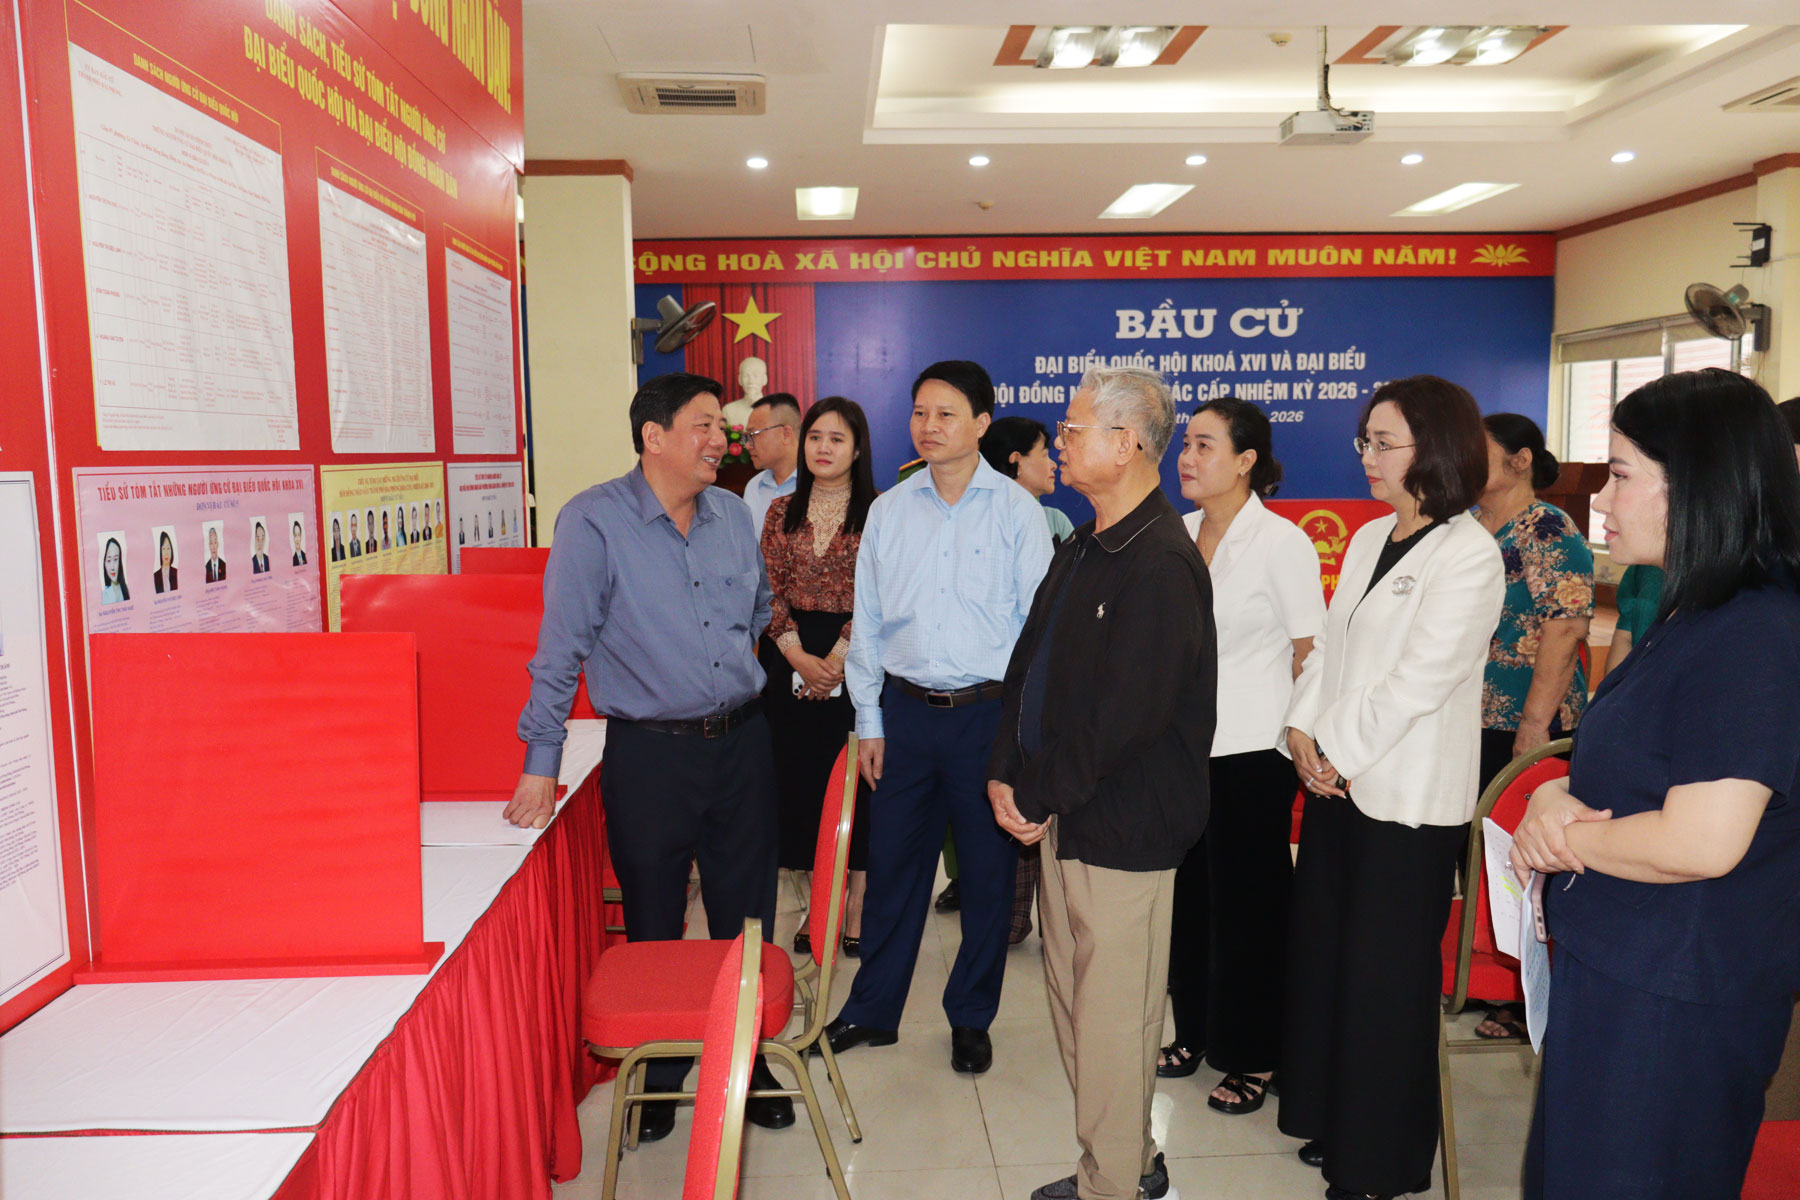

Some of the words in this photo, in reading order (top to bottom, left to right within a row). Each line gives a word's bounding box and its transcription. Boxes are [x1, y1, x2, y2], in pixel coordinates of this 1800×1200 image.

[299, 15, 330, 69] SÁCH,
[331, 39, 351, 81] TIỂU
[353, 56, 366, 92] SỬ
[366, 70, 384, 108] TÓM
[385, 82, 399, 119] TẮT
[244, 24, 266, 72] ĐẠI
[268, 41, 295, 88] BIỂU
[297, 65, 325, 110] QUỐC
[327, 85, 344, 126] HỘI
[345, 98, 358, 132] VÀ
[358, 109, 373, 146] ĐẠI
[374, 118, 393, 155] BIỂU
[634, 251, 706, 275] ỘNG
[717, 250, 784, 271] HOÀ
[795, 250, 839, 270] XÃ
[850, 249, 904, 272] HỘI
[915, 246, 981, 268] CHỦ
[992, 247, 1093, 268] NGHĨA
[1104, 247, 1171, 270] VIỆT
[1181, 250, 1256, 266] NAM
[1268, 246, 1362, 265] MUÔN
[1373, 245, 1457, 265] NĂM!
[1115, 299, 1217, 339] BẦU
[1230, 300, 1303, 338] CỬ
[1034, 356, 1063, 377] ĐẠI
[1067, 349, 1107, 373] BIỂU
[1159, 351, 1187, 376] HỘI
[1192, 351, 1236, 372] KHOÁ
[1240, 354, 1266, 371] XVI
[1271, 350, 1292, 371] VÀ
[1296, 353, 1324, 374] ĐẠI
[1328, 346, 1366, 370] BIỂU
[1018, 381, 1065, 403] ĐỒNG
[1197, 378, 1231, 401] CẤP
[1235, 380, 1288, 404] NHIỆM
[1293, 379, 1314, 399] KỲ
[1318, 382, 1357, 399] 2026
[1270, 411, 1304, 423] 2026
[97, 481, 116, 501] TIỂU
[118, 481, 129, 500] SỬ
[130, 482, 147, 499] TÓM
